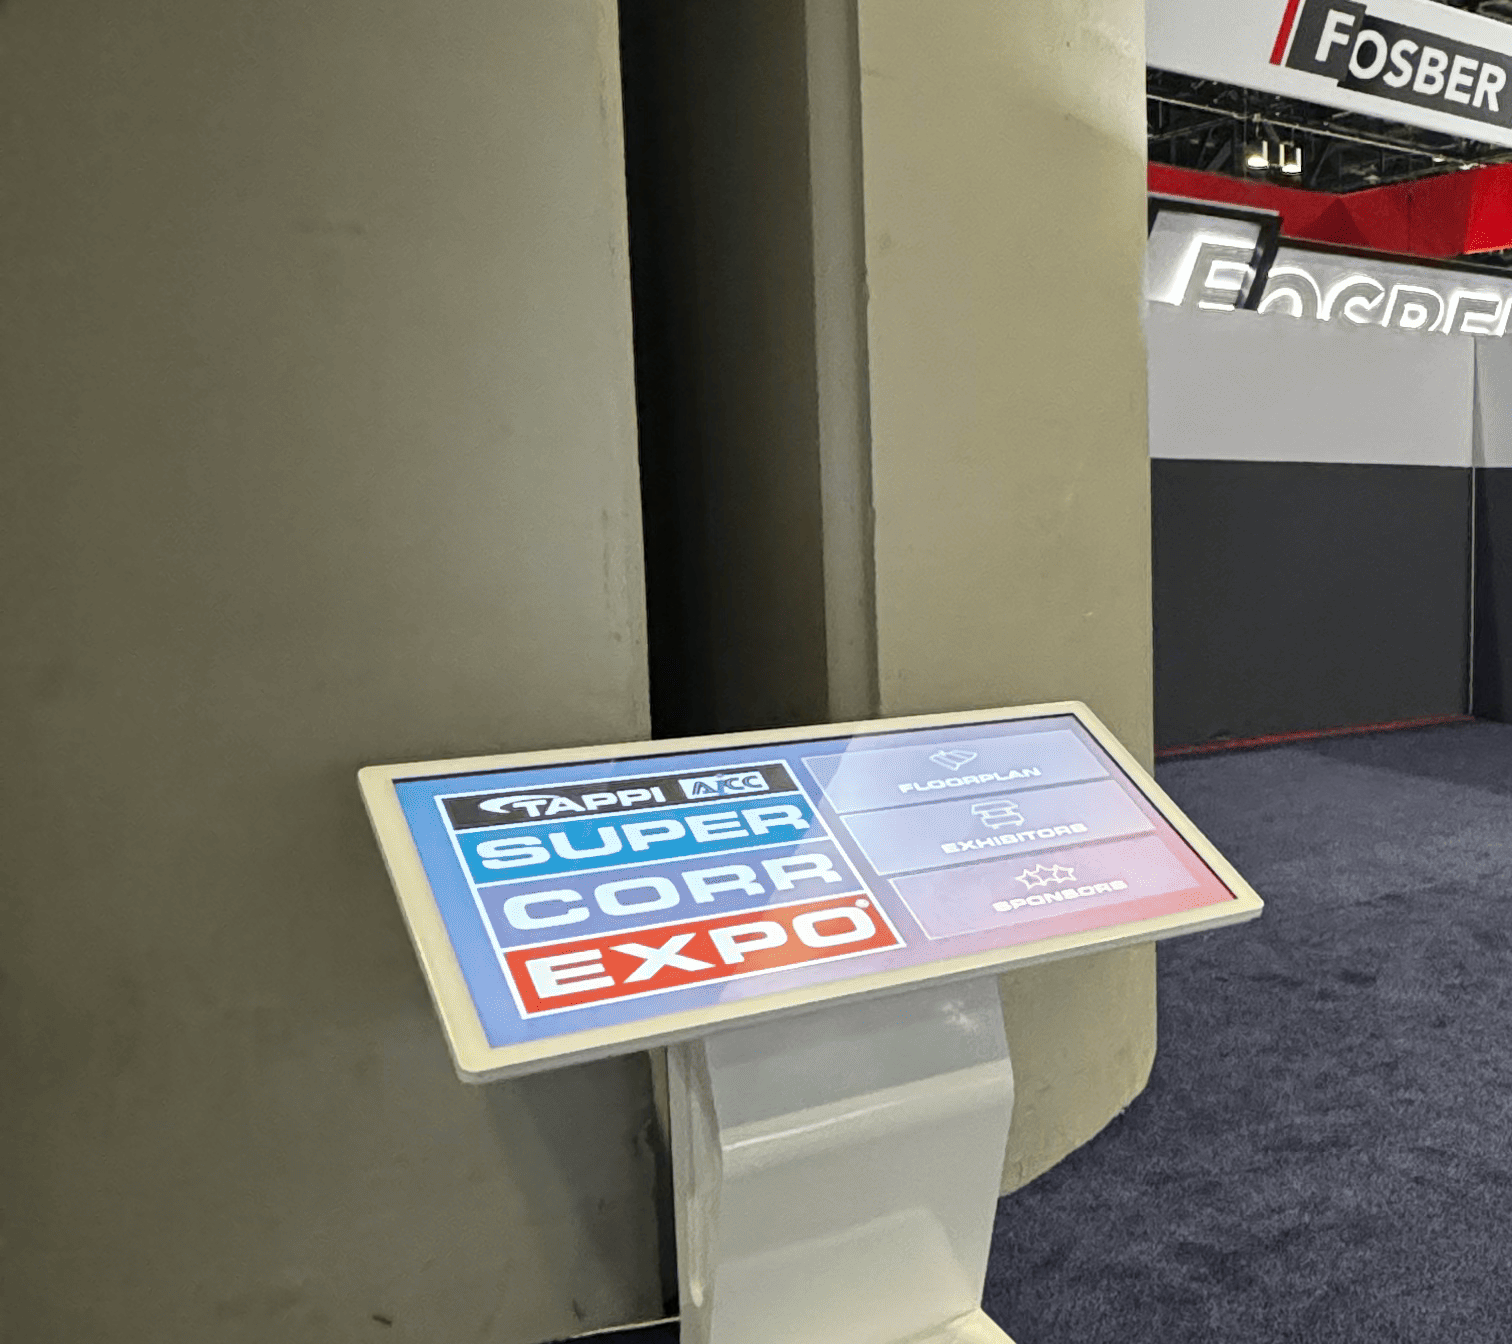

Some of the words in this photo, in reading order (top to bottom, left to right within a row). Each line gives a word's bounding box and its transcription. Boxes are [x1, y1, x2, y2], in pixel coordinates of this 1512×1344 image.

[1314, 9, 1507, 112] FOSBER
[510, 786, 667, 818] TAPPI
[898, 767, 1042, 794] FLOORPLAN
[476, 804, 810, 870] SUPER
[941, 823, 1089, 854] EXHIBITORS
[503, 853, 843, 930] CORR
[992, 880, 1129, 913] SPONSORS
[524, 904, 877, 999] EXPO
